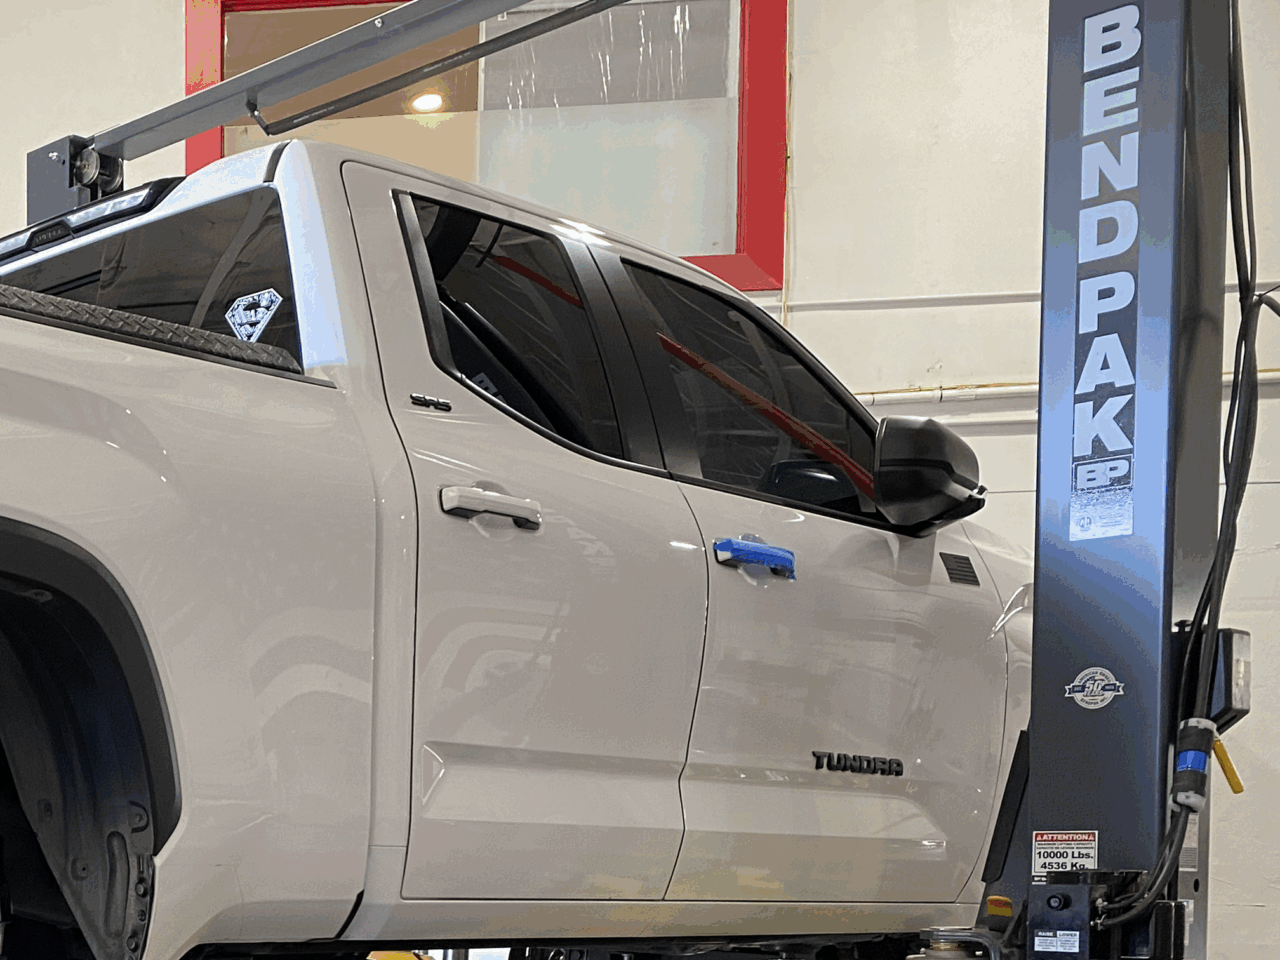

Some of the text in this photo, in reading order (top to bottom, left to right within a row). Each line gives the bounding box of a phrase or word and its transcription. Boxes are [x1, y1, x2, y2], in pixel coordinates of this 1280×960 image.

[1073, 4, 1141, 457] BENDPAK
[410, 393, 452, 412] SR5
[1077, 460, 1130, 489] BP
[812, 751, 903, 776] TUNDRA
[1036, 850, 1094, 859] 10000 Lbs.
[1040, 861, 1068, 870] 4536
